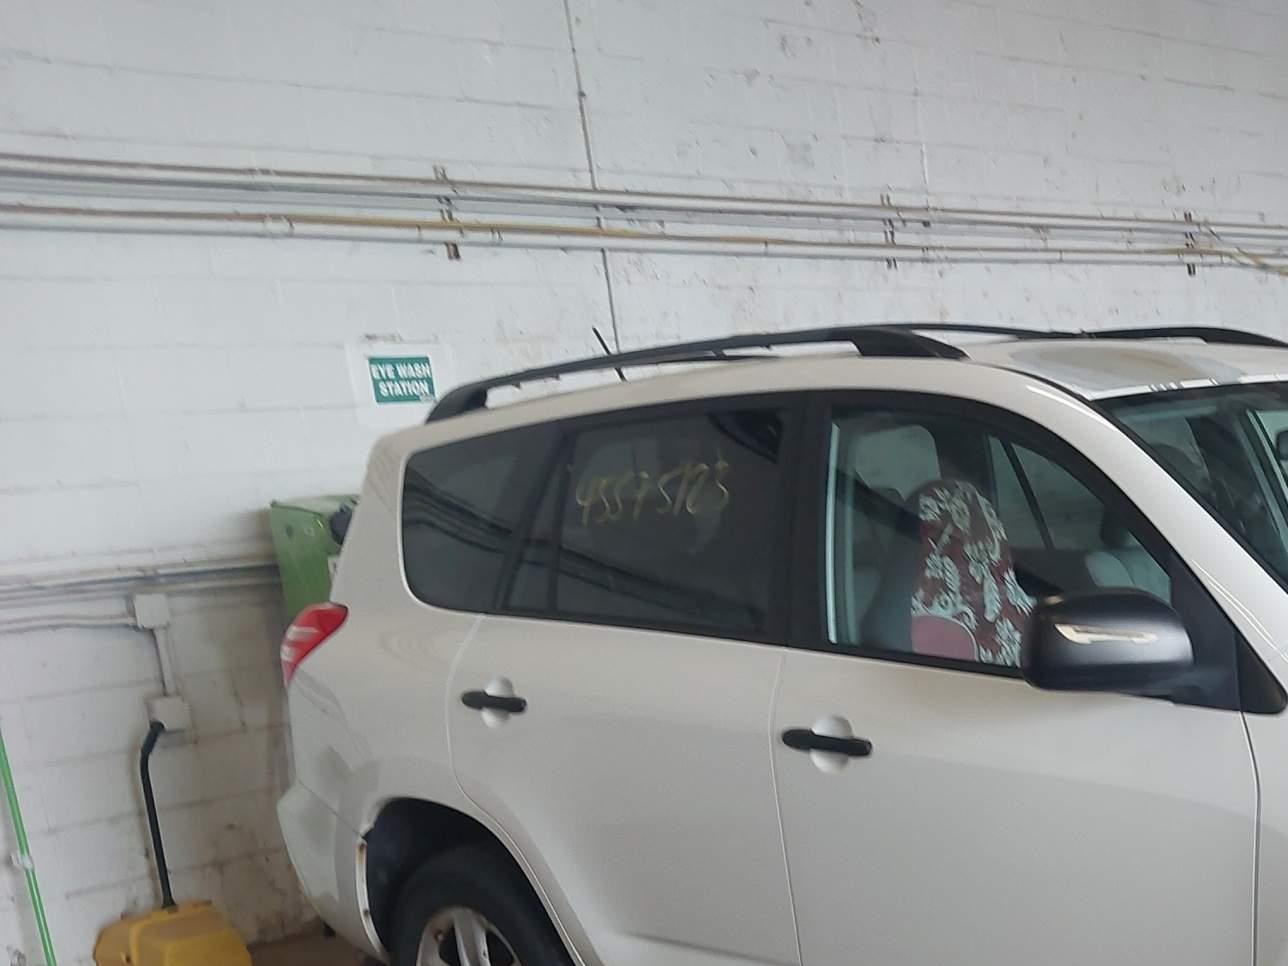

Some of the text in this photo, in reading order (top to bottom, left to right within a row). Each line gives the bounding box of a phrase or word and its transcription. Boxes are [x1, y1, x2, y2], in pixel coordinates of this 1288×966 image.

[370, 363, 431, 380] EYE WASH
[379, 380, 430, 396] STATION
